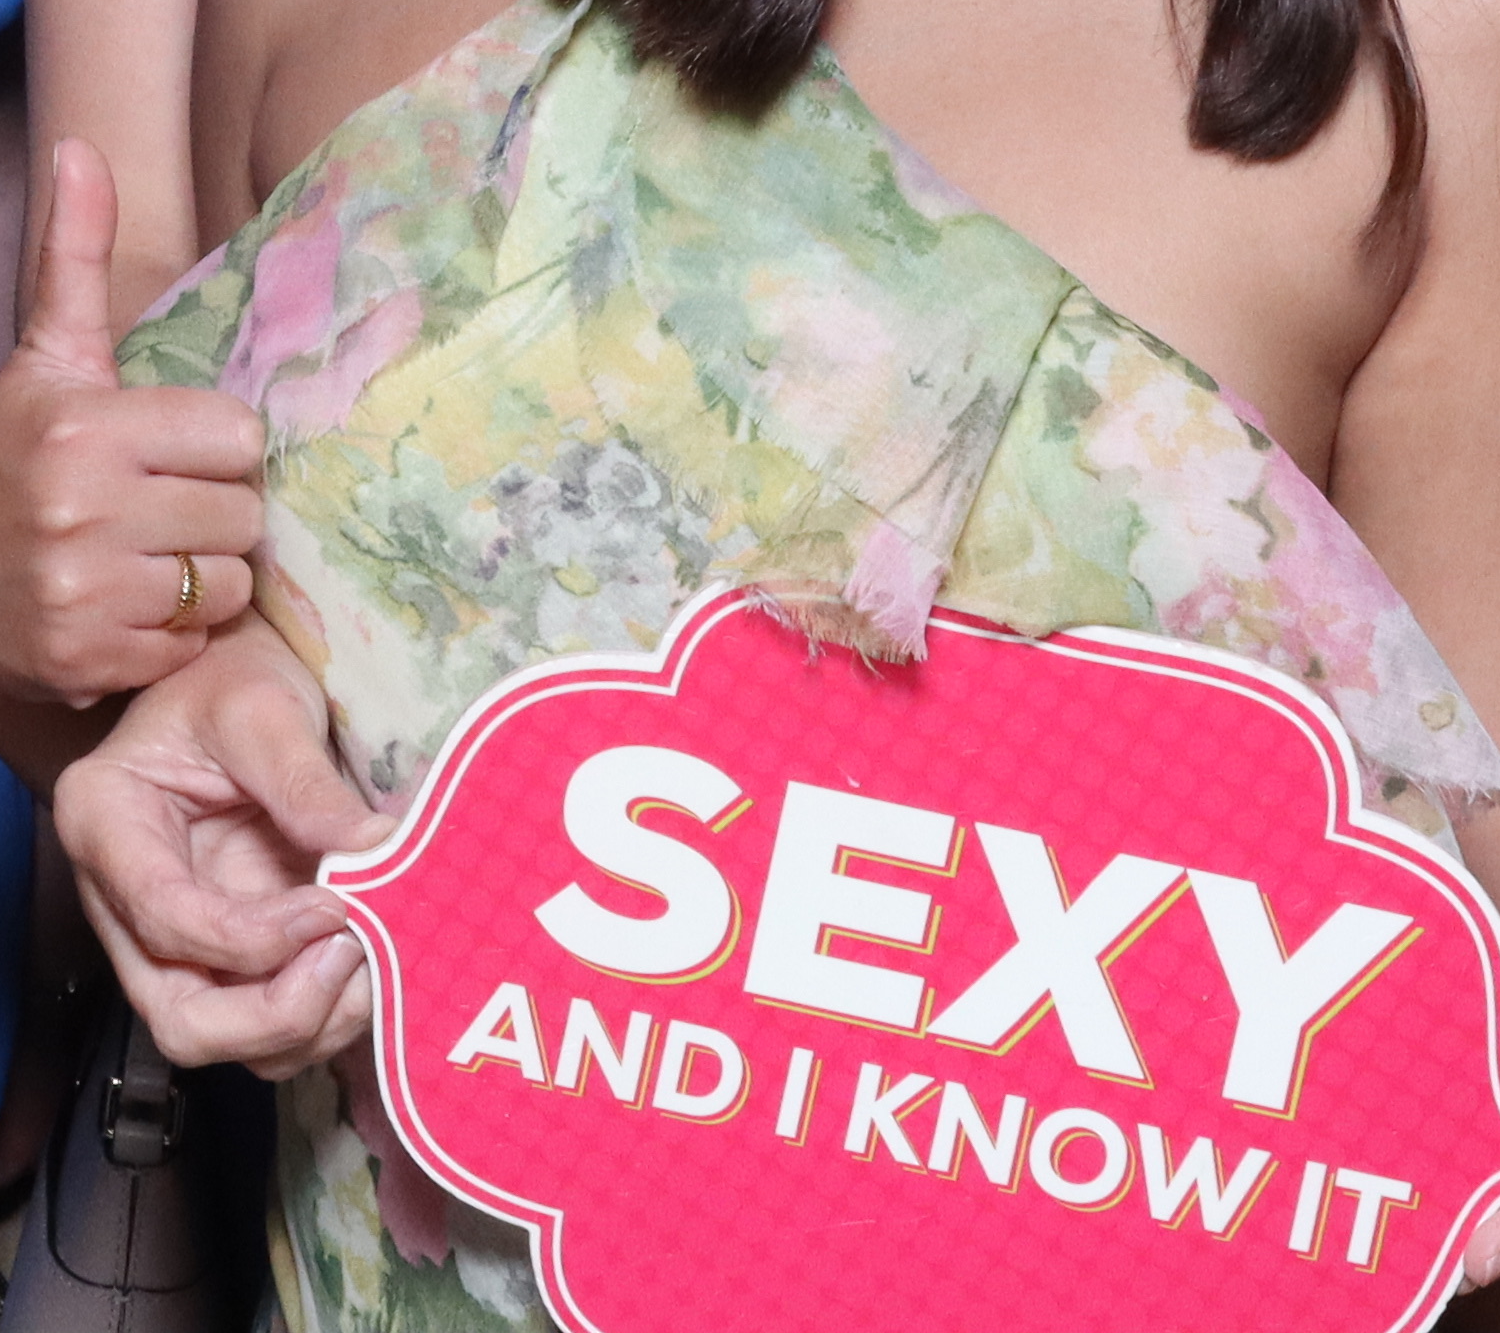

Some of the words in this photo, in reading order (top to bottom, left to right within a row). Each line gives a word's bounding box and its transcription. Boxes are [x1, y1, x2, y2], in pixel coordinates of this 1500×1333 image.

[535, 746, 1422, 1117] SEXY
[448, 983, 750, 1123] AND
[777, 1048, 820, 1145] I
[845, 1063, 1278, 1240] KNOW
[1290, 1162, 1417, 1273] IT
